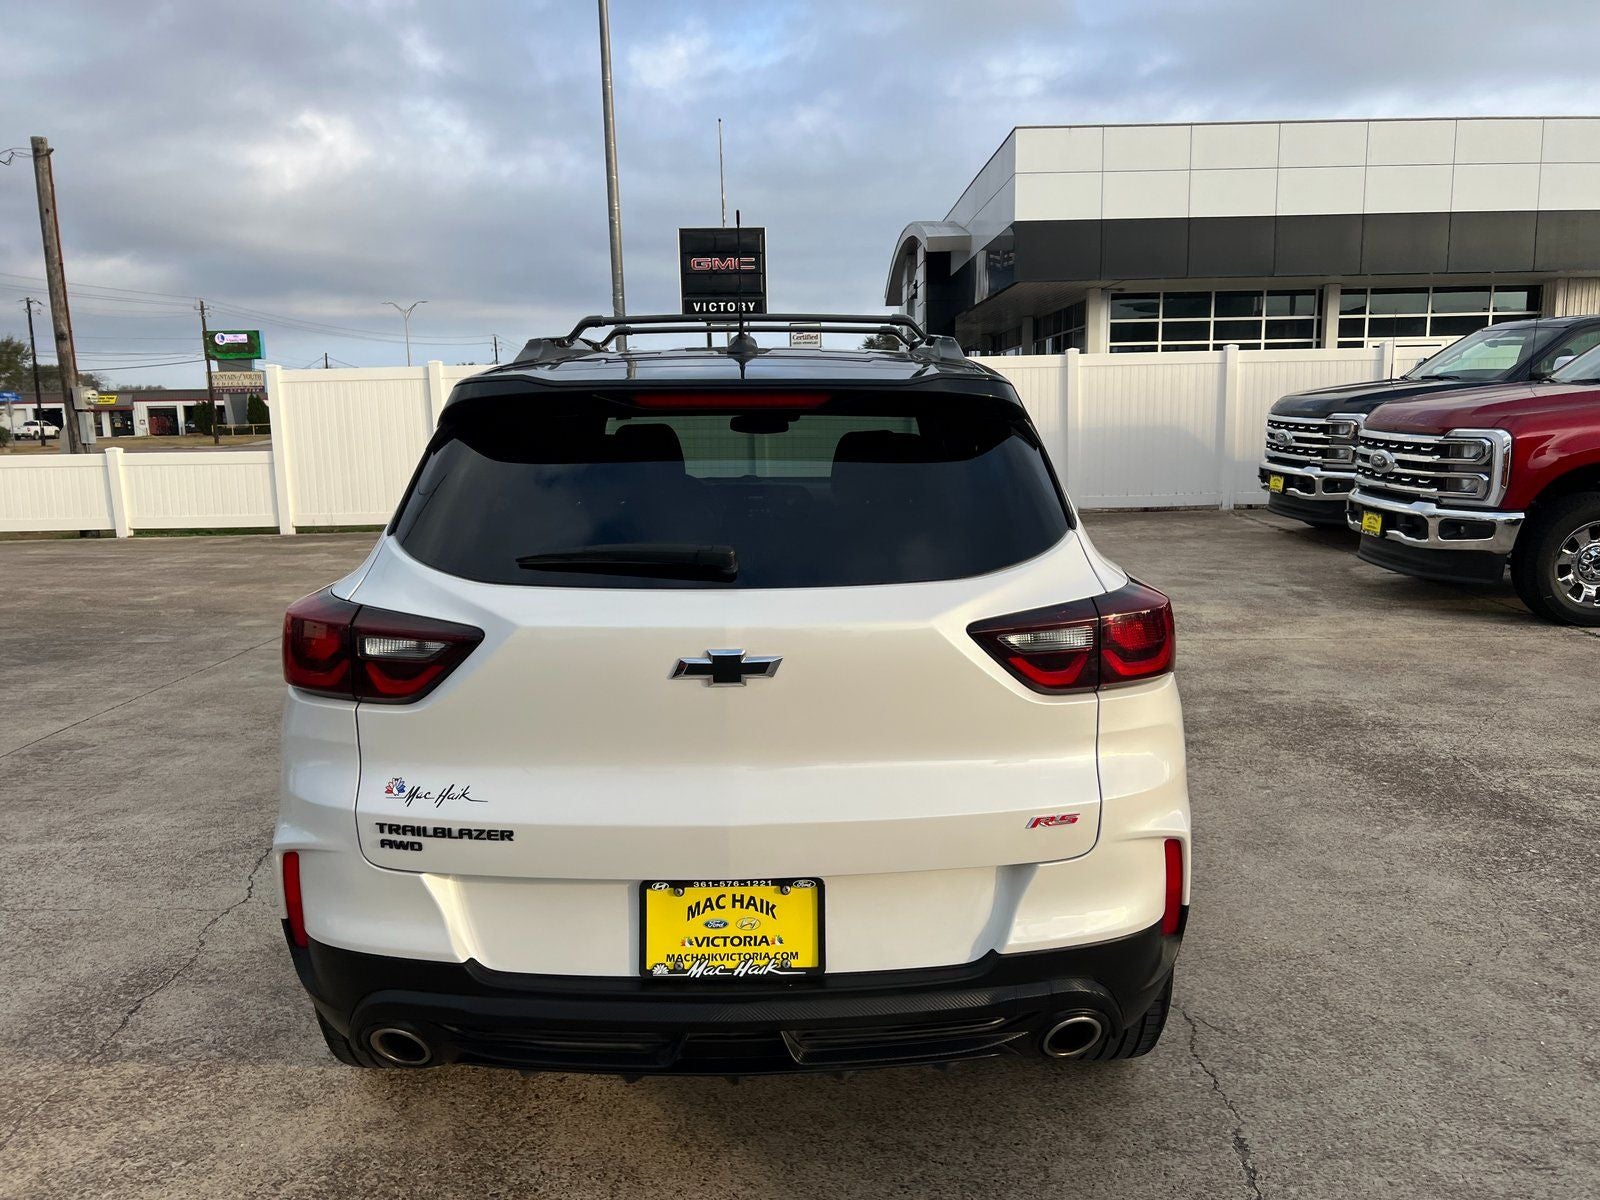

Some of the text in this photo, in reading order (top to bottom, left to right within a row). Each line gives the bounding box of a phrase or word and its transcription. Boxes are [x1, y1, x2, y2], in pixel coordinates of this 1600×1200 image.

[691, 257, 755, 270] GMC
[693, 301, 755, 312] VICTORY
[792, 334, 818, 342] Certified
[404, 784, 488, 808] Mac Haik
[1025, 813, 1080, 829] RS
[375, 822, 515, 841] TRAILBLAZER
[380, 838, 423, 851] AWD
[693, 880, 773, 888] 361-576-1221
[686, 893, 777, 922] MAC HAIK
[706, 920, 726, 929] Ford
[694, 935, 771, 948] VICTORIA
[686, 958, 806, 978] Mac Haik
